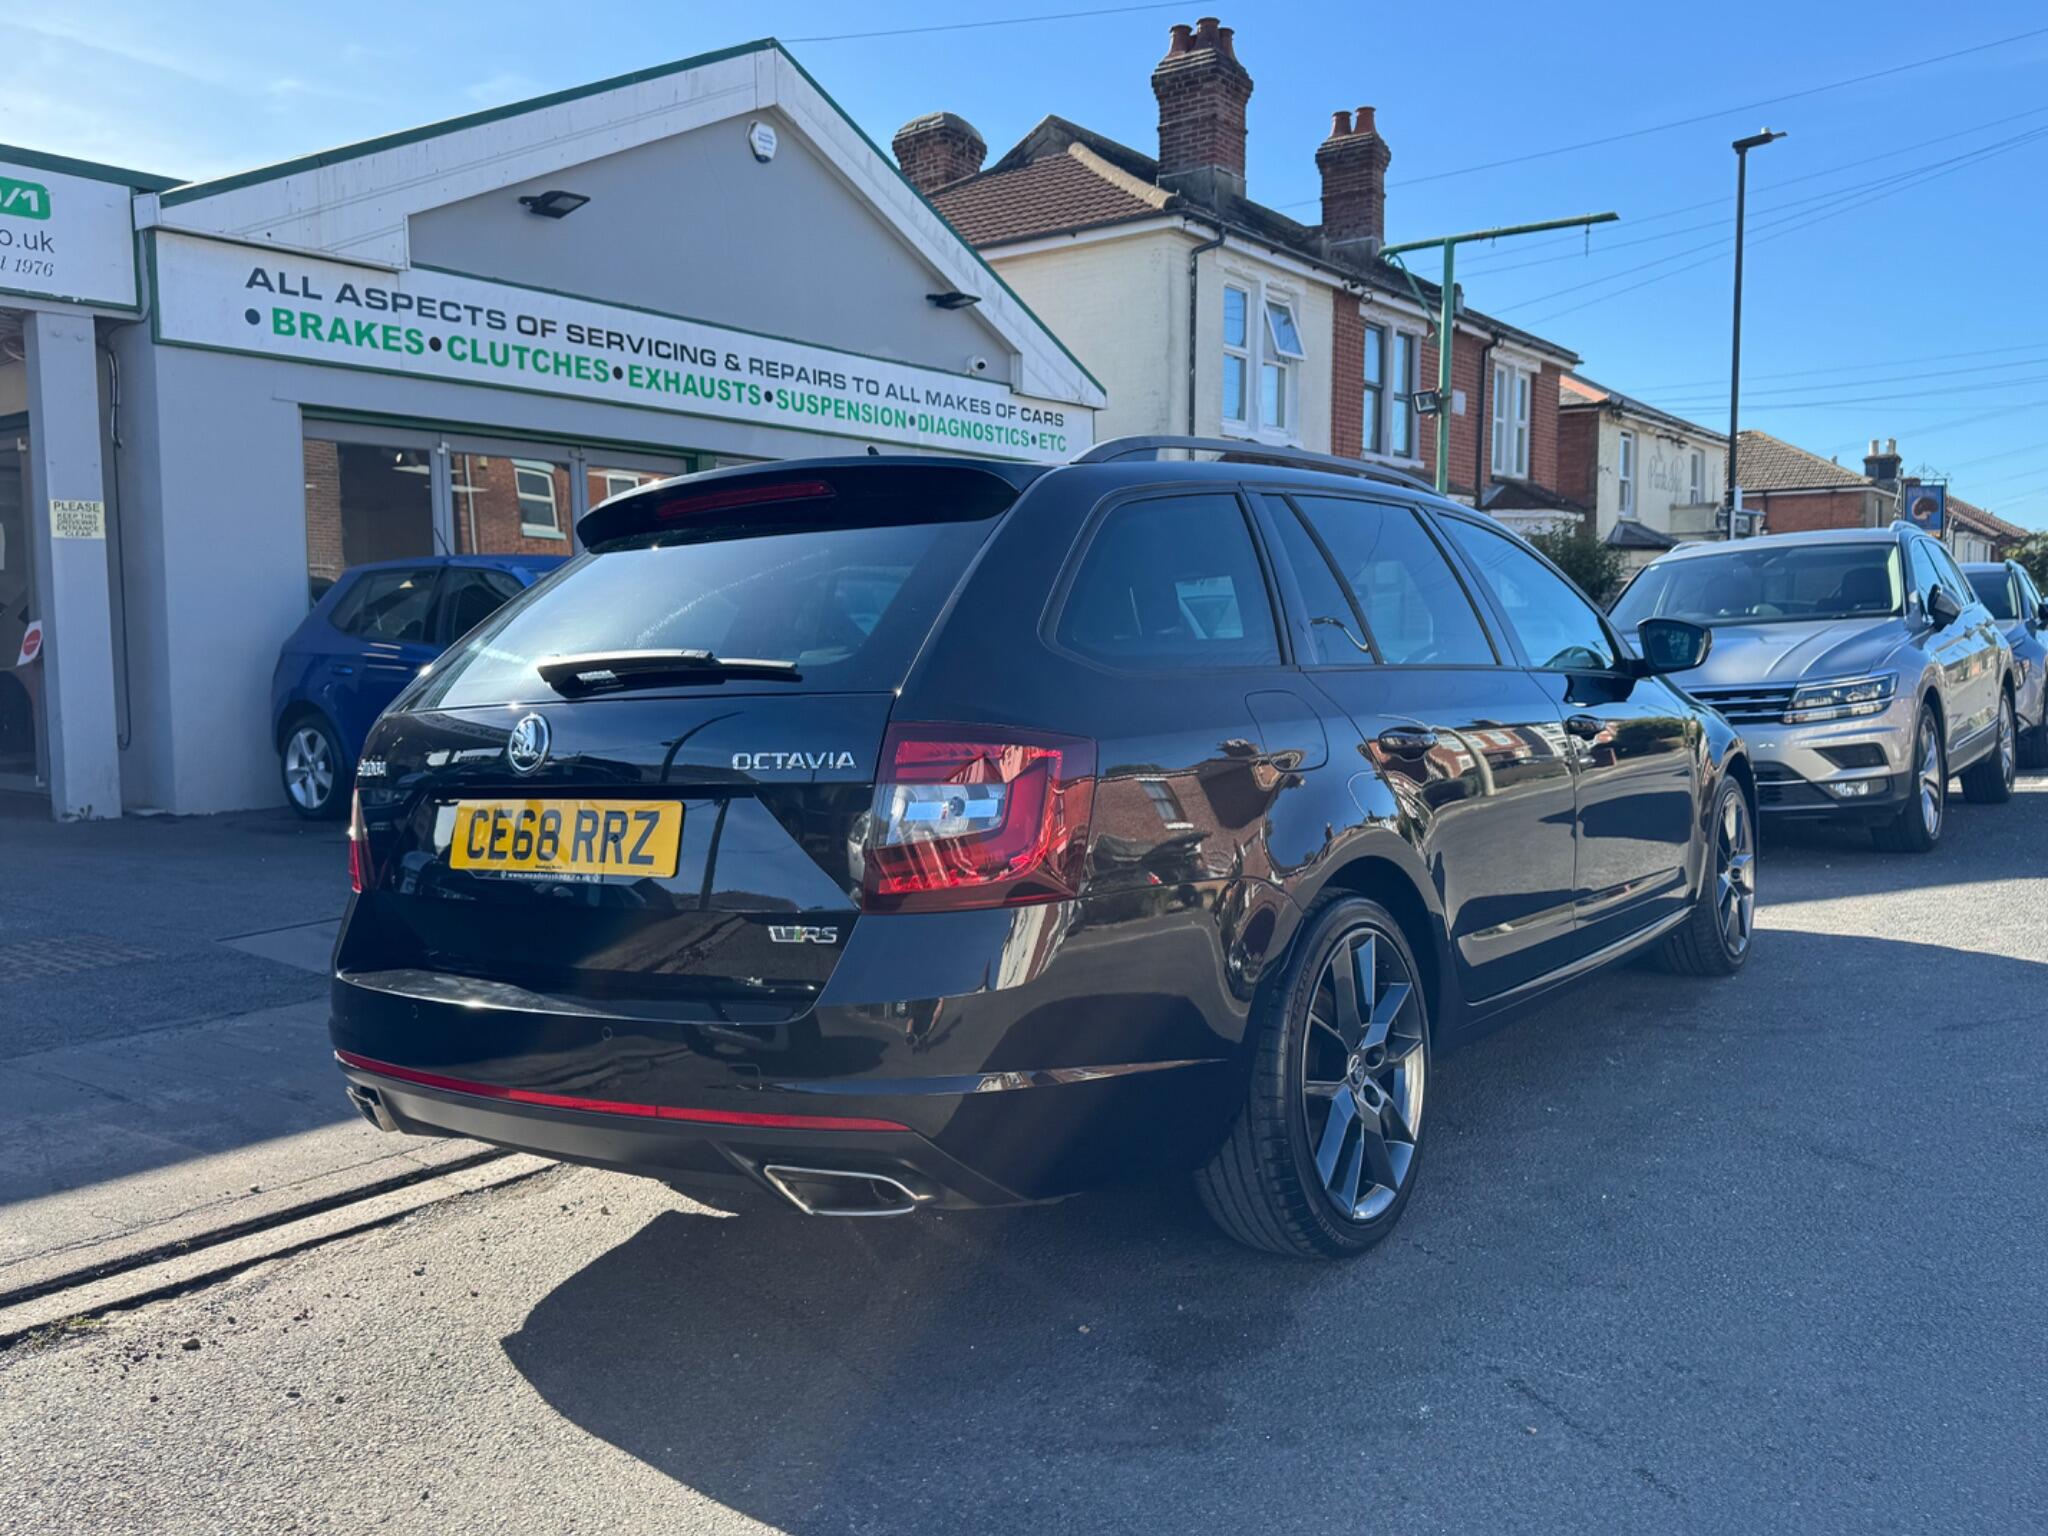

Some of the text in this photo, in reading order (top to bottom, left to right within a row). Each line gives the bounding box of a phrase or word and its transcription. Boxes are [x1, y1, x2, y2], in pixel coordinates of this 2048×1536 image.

[15, 257, 54, 278] 1976
[245, 267, 1065, 428] ALL ASPECTS OF SERVICING & REPAIRS TO ALL MAKES OF CARS
[271, 306, 1066, 452] BRAKES CLUTCHES EXHAUSTS SUSPENSION DIAGNOSTICS ETC
[53, 501, 100, 513] PLEASE
[732, 752, 857, 770] OCTAVIA
[466, 809, 661, 866] CE68 RRZ
